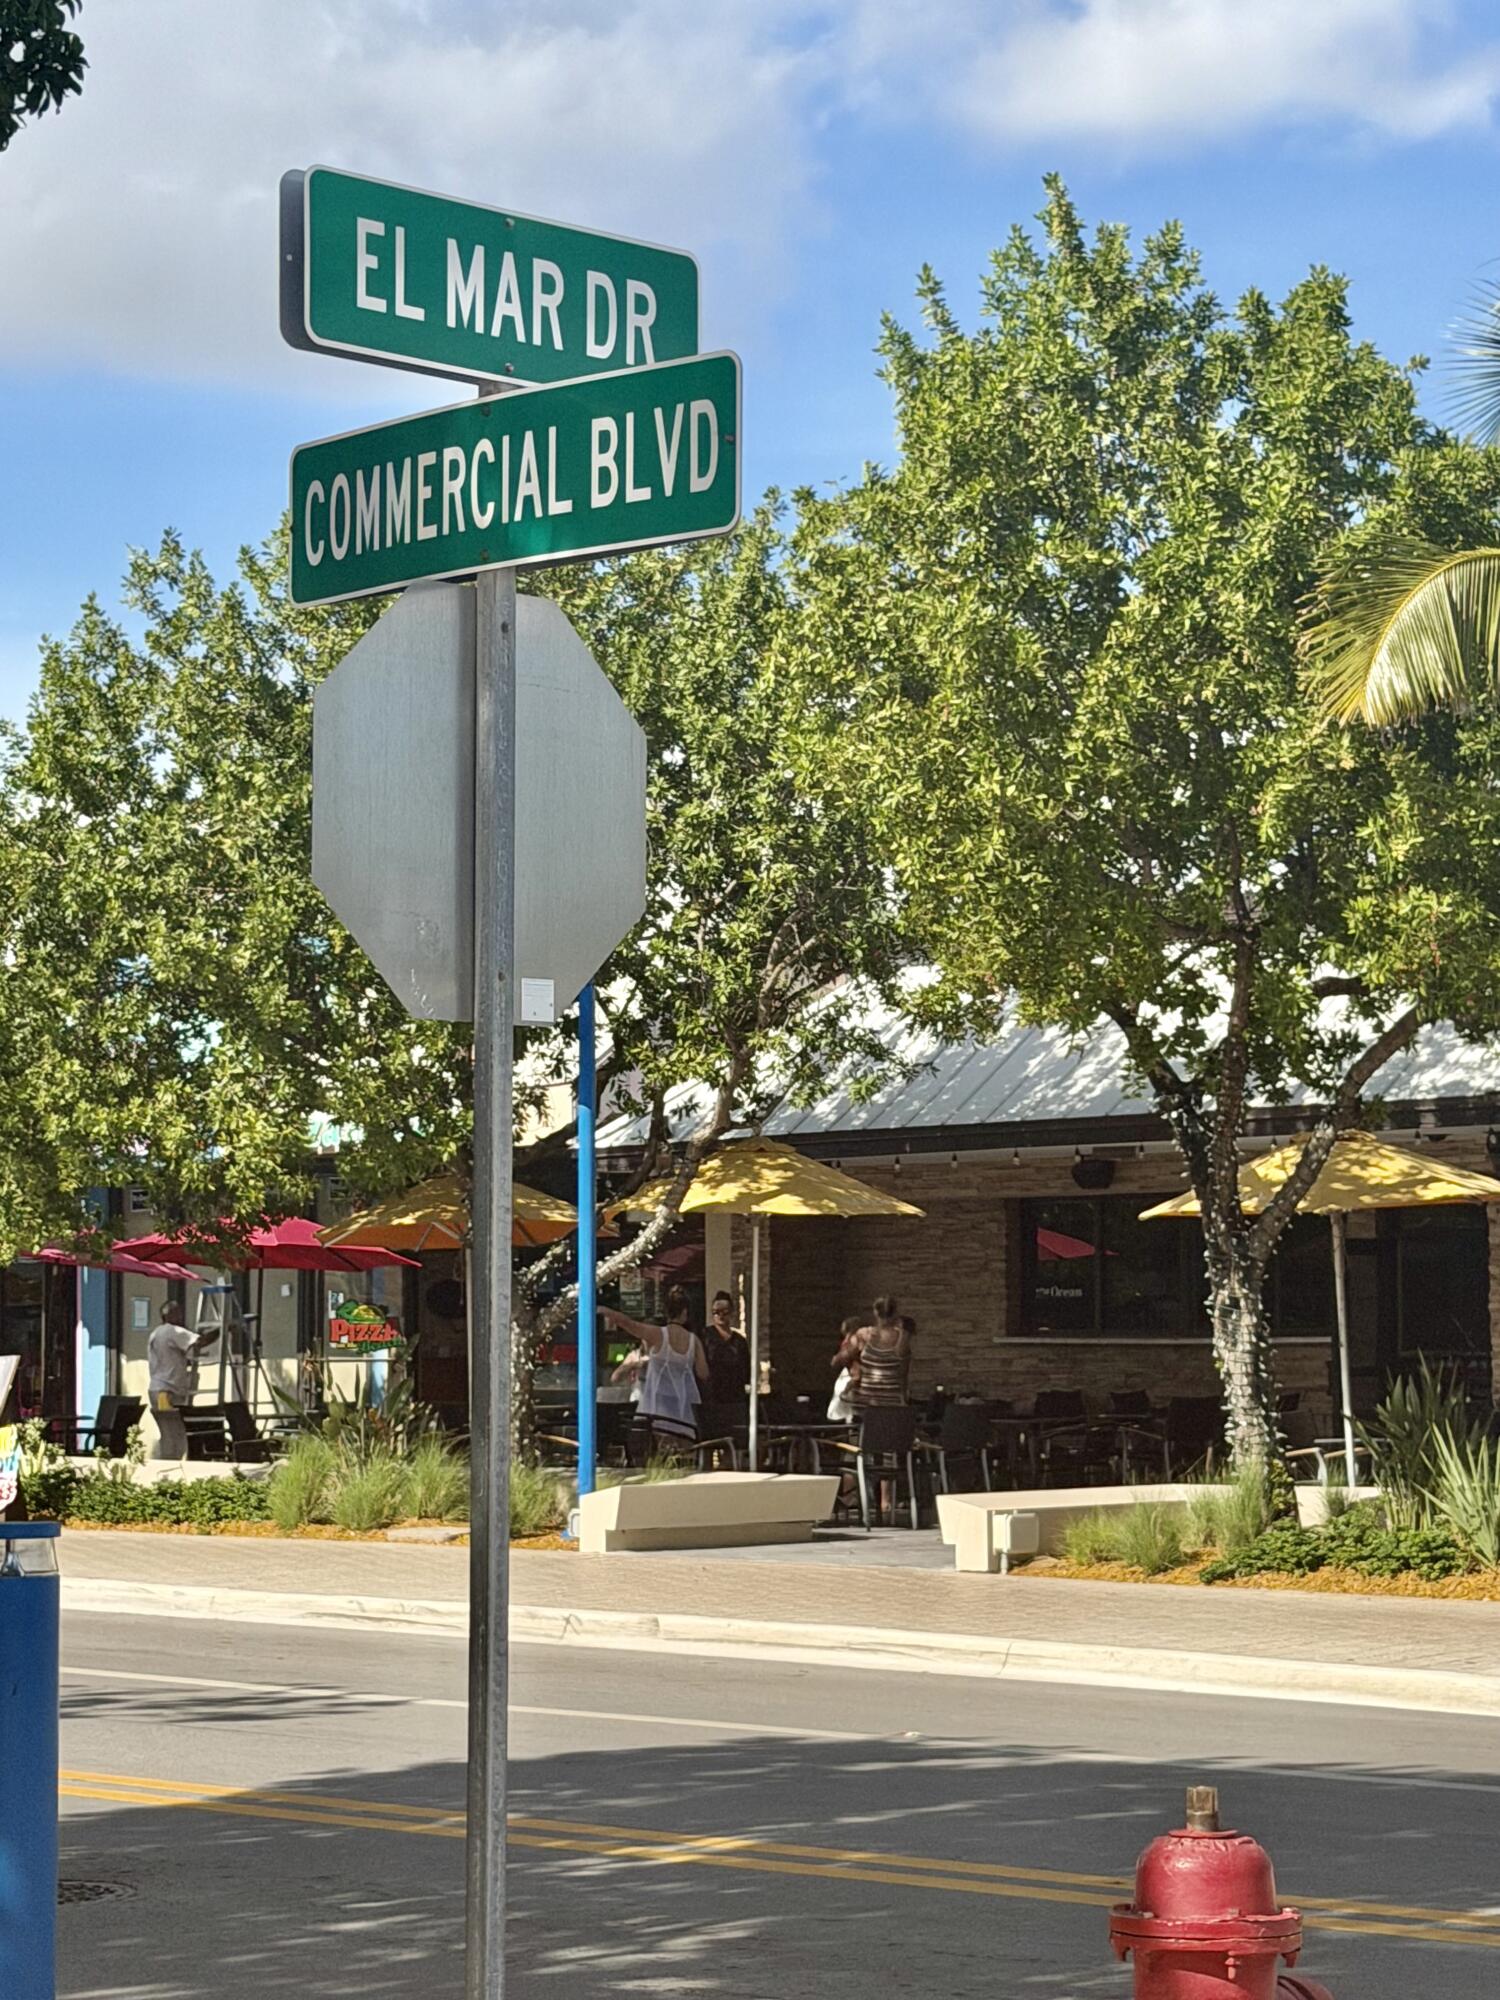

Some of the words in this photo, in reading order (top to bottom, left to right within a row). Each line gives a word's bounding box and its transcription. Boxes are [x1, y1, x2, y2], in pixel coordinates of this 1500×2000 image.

[356, 217, 425, 321] EL
[446, 238, 564, 351] MAR
[586, 270, 657, 365] DR
[305, 426, 573, 566] COMMERCIAL
[590, 399, 718, 508] BLVD
